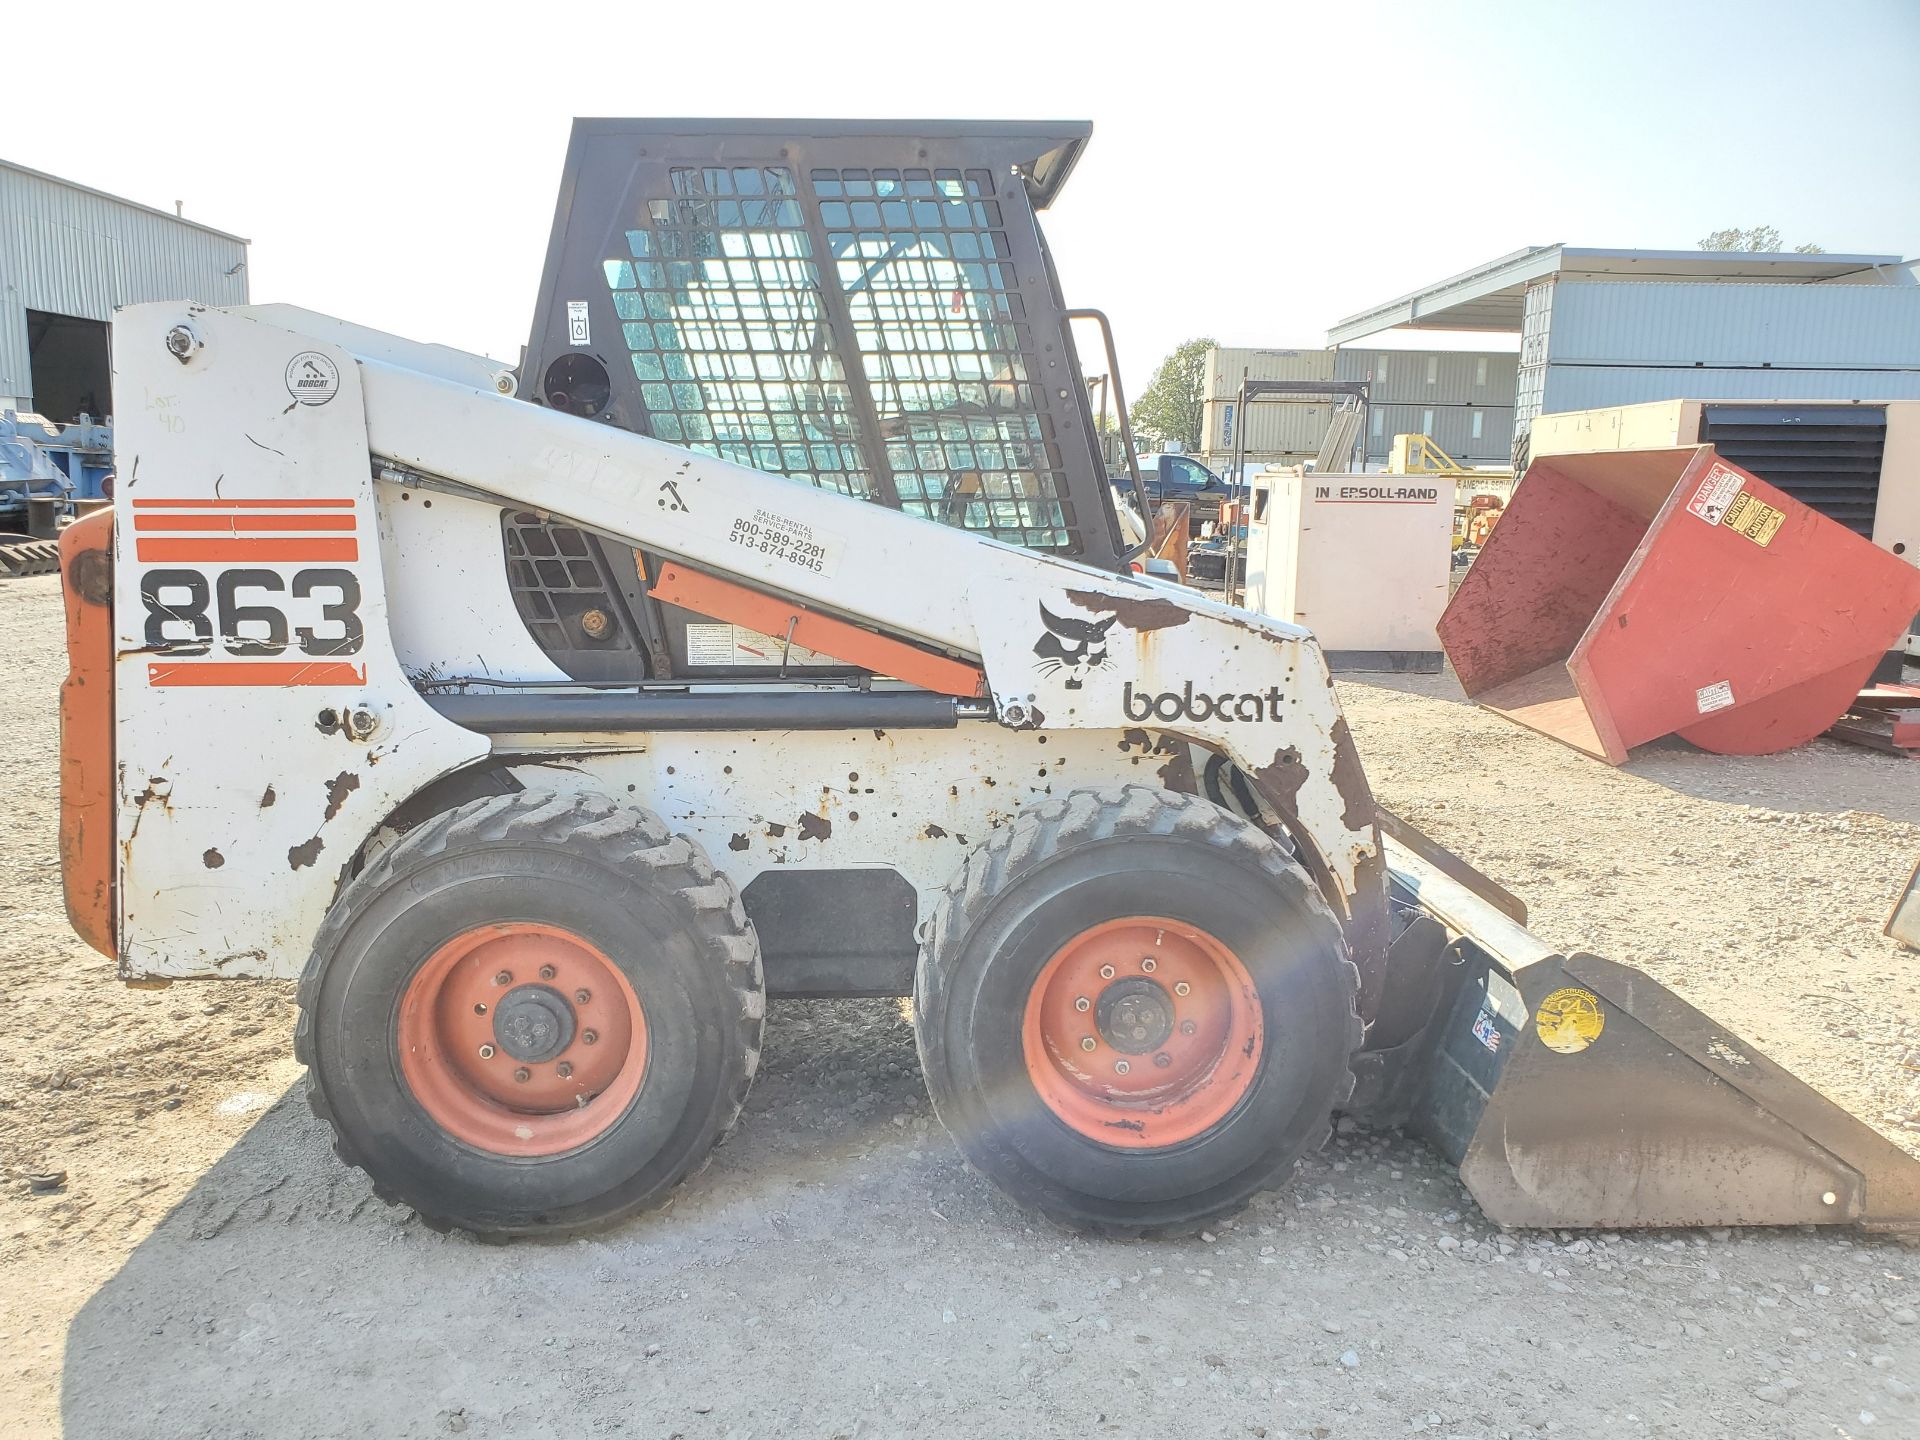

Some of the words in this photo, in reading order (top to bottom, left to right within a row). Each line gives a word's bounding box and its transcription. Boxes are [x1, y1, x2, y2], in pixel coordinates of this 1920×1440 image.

[297, 379, 329, 388] BOBCAT
[1316, 487, 1437, 499] INERSOLL-RAND
[1696, 468, 1722, 502] DANGER
[756, 509, 813, 534] SALES-RENTAL
[1725, 494, 1750, 524] CAUTION
[1748, 507, 1772, 537] CAUTION
[734, 518, 825, 559] 800-589-2281
[753, 515, 813, 540] SERVICE-PARTS
[729, 530, 824, 572] 513-874-8945
[141, 569, 364, 657] 863
[1123, 680, 1284, 722] bobcat
